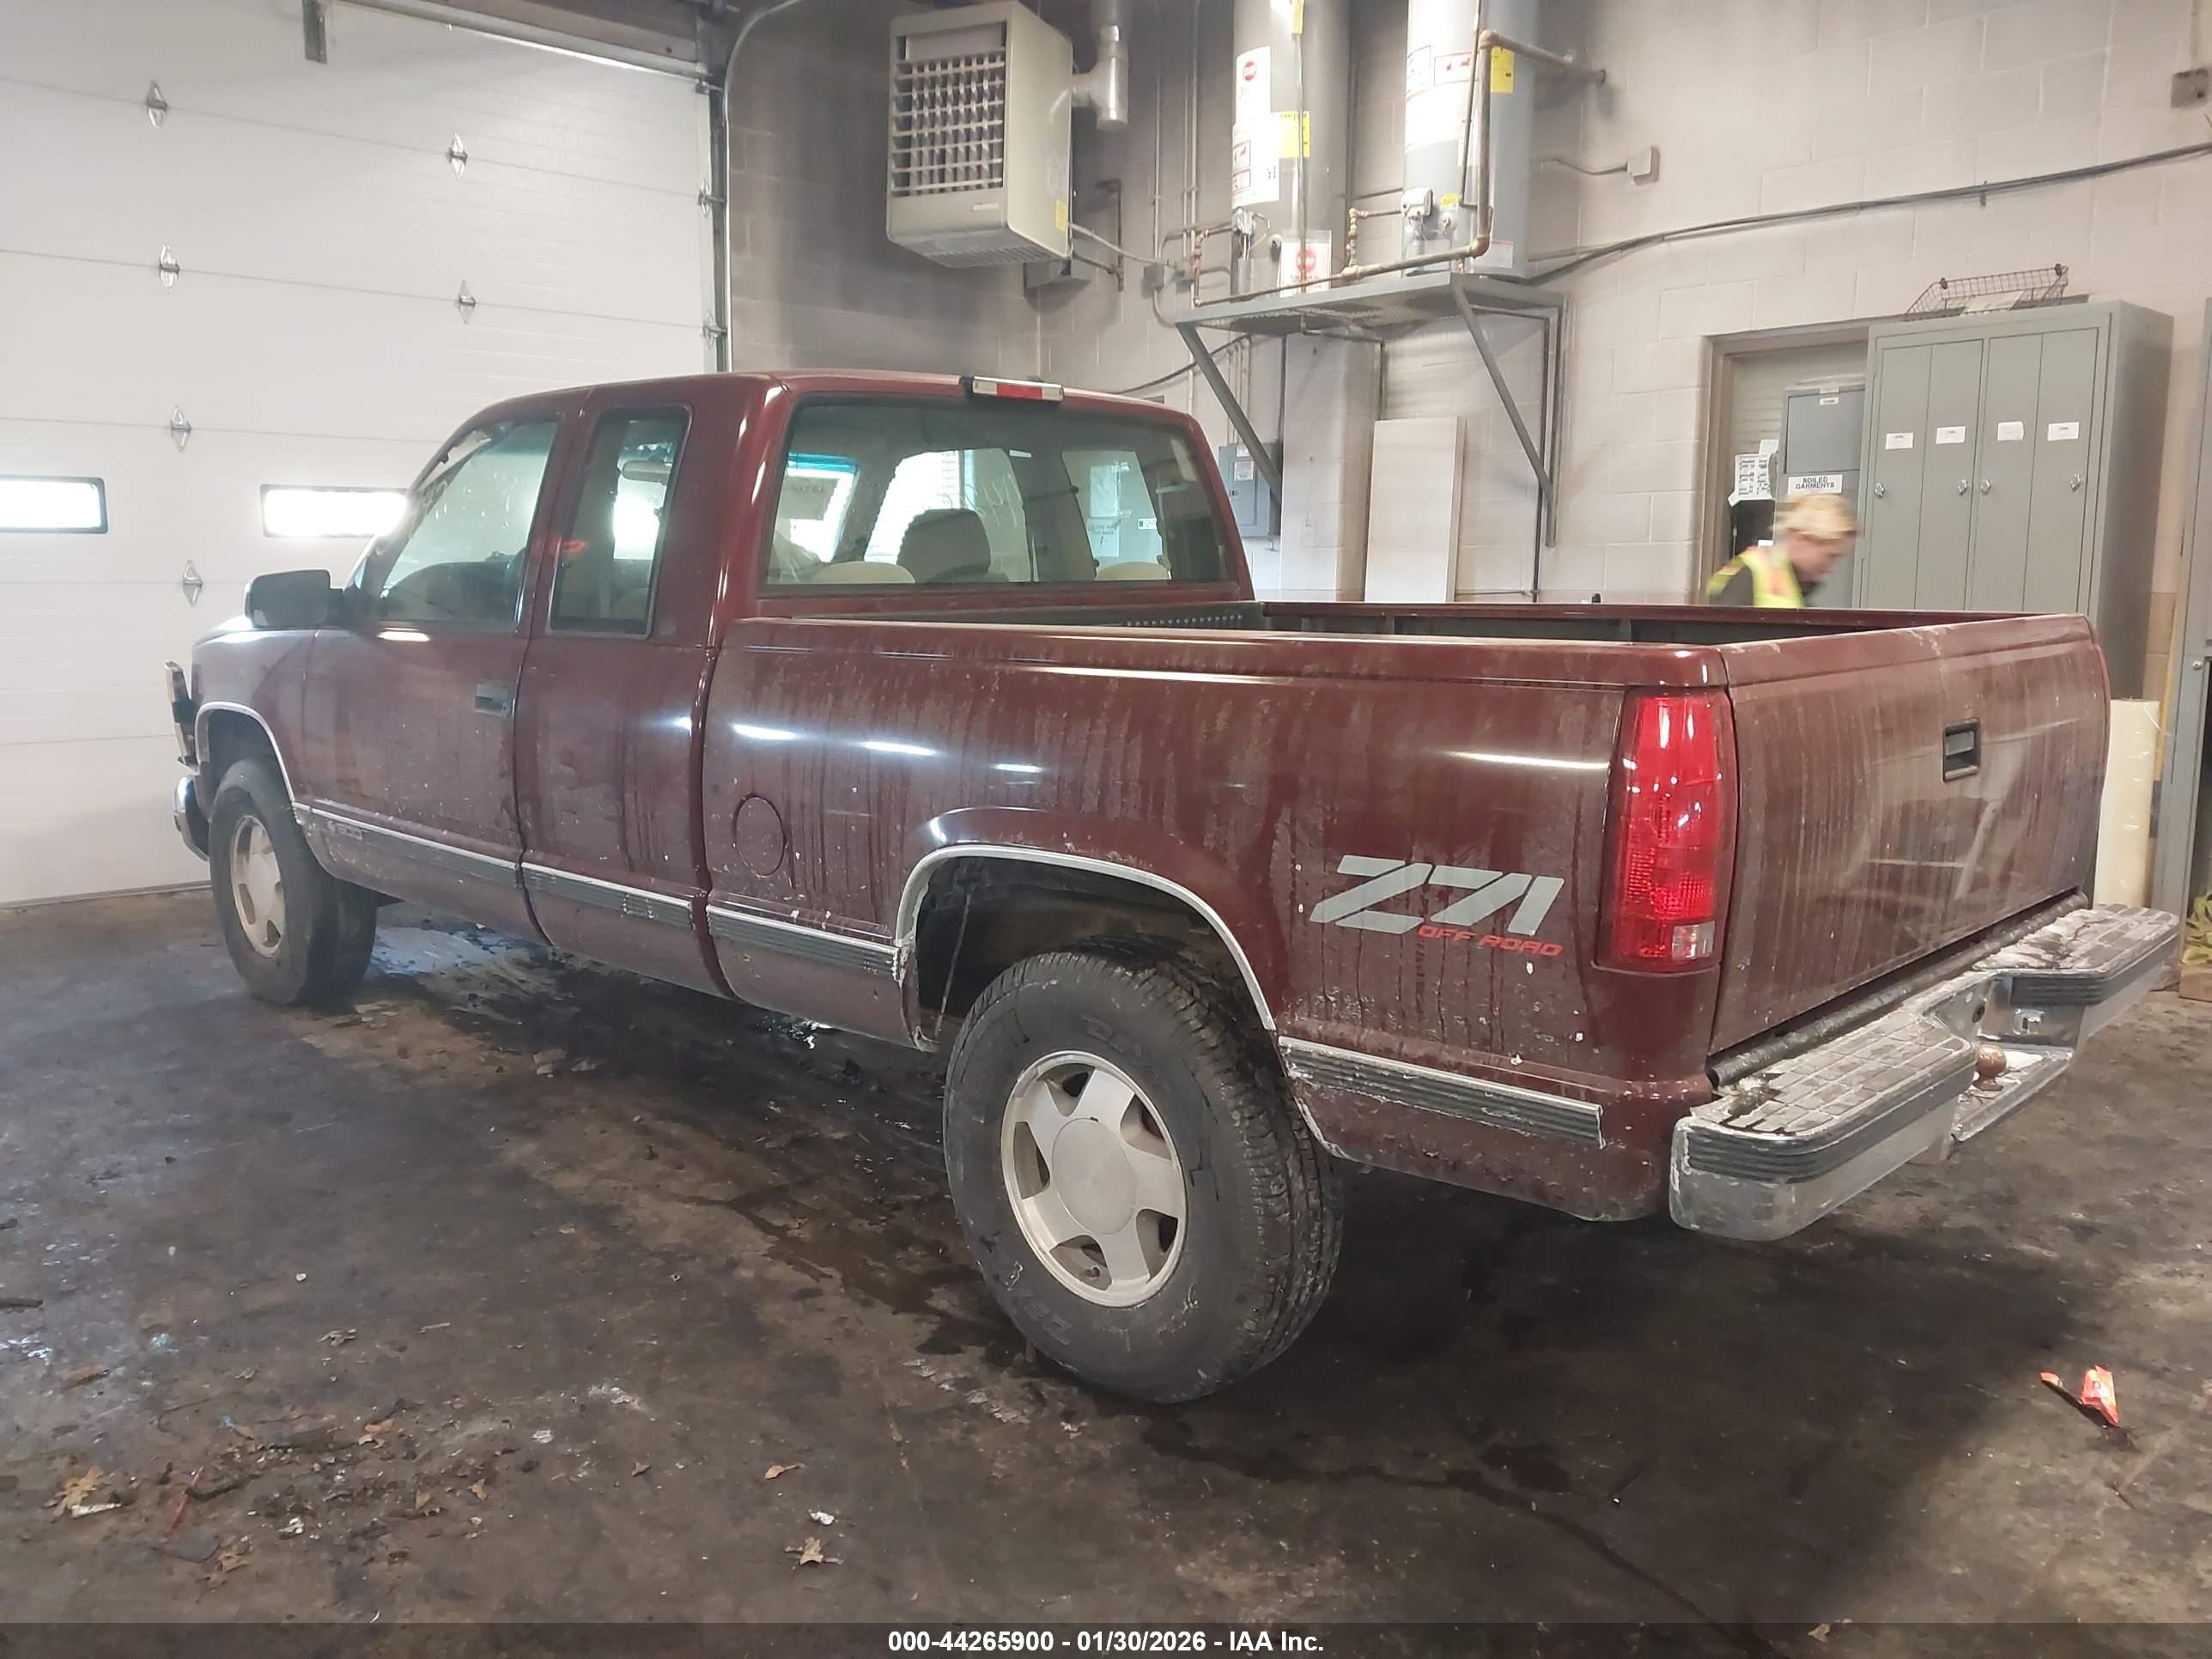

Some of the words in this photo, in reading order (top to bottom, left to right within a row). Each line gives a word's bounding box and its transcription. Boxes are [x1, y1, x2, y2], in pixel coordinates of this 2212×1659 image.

[1310, 854, 1565, 937] Z71
[1416, 924, 1477, 943] OFF
[1479, 934, 1565, 957] ROAD
